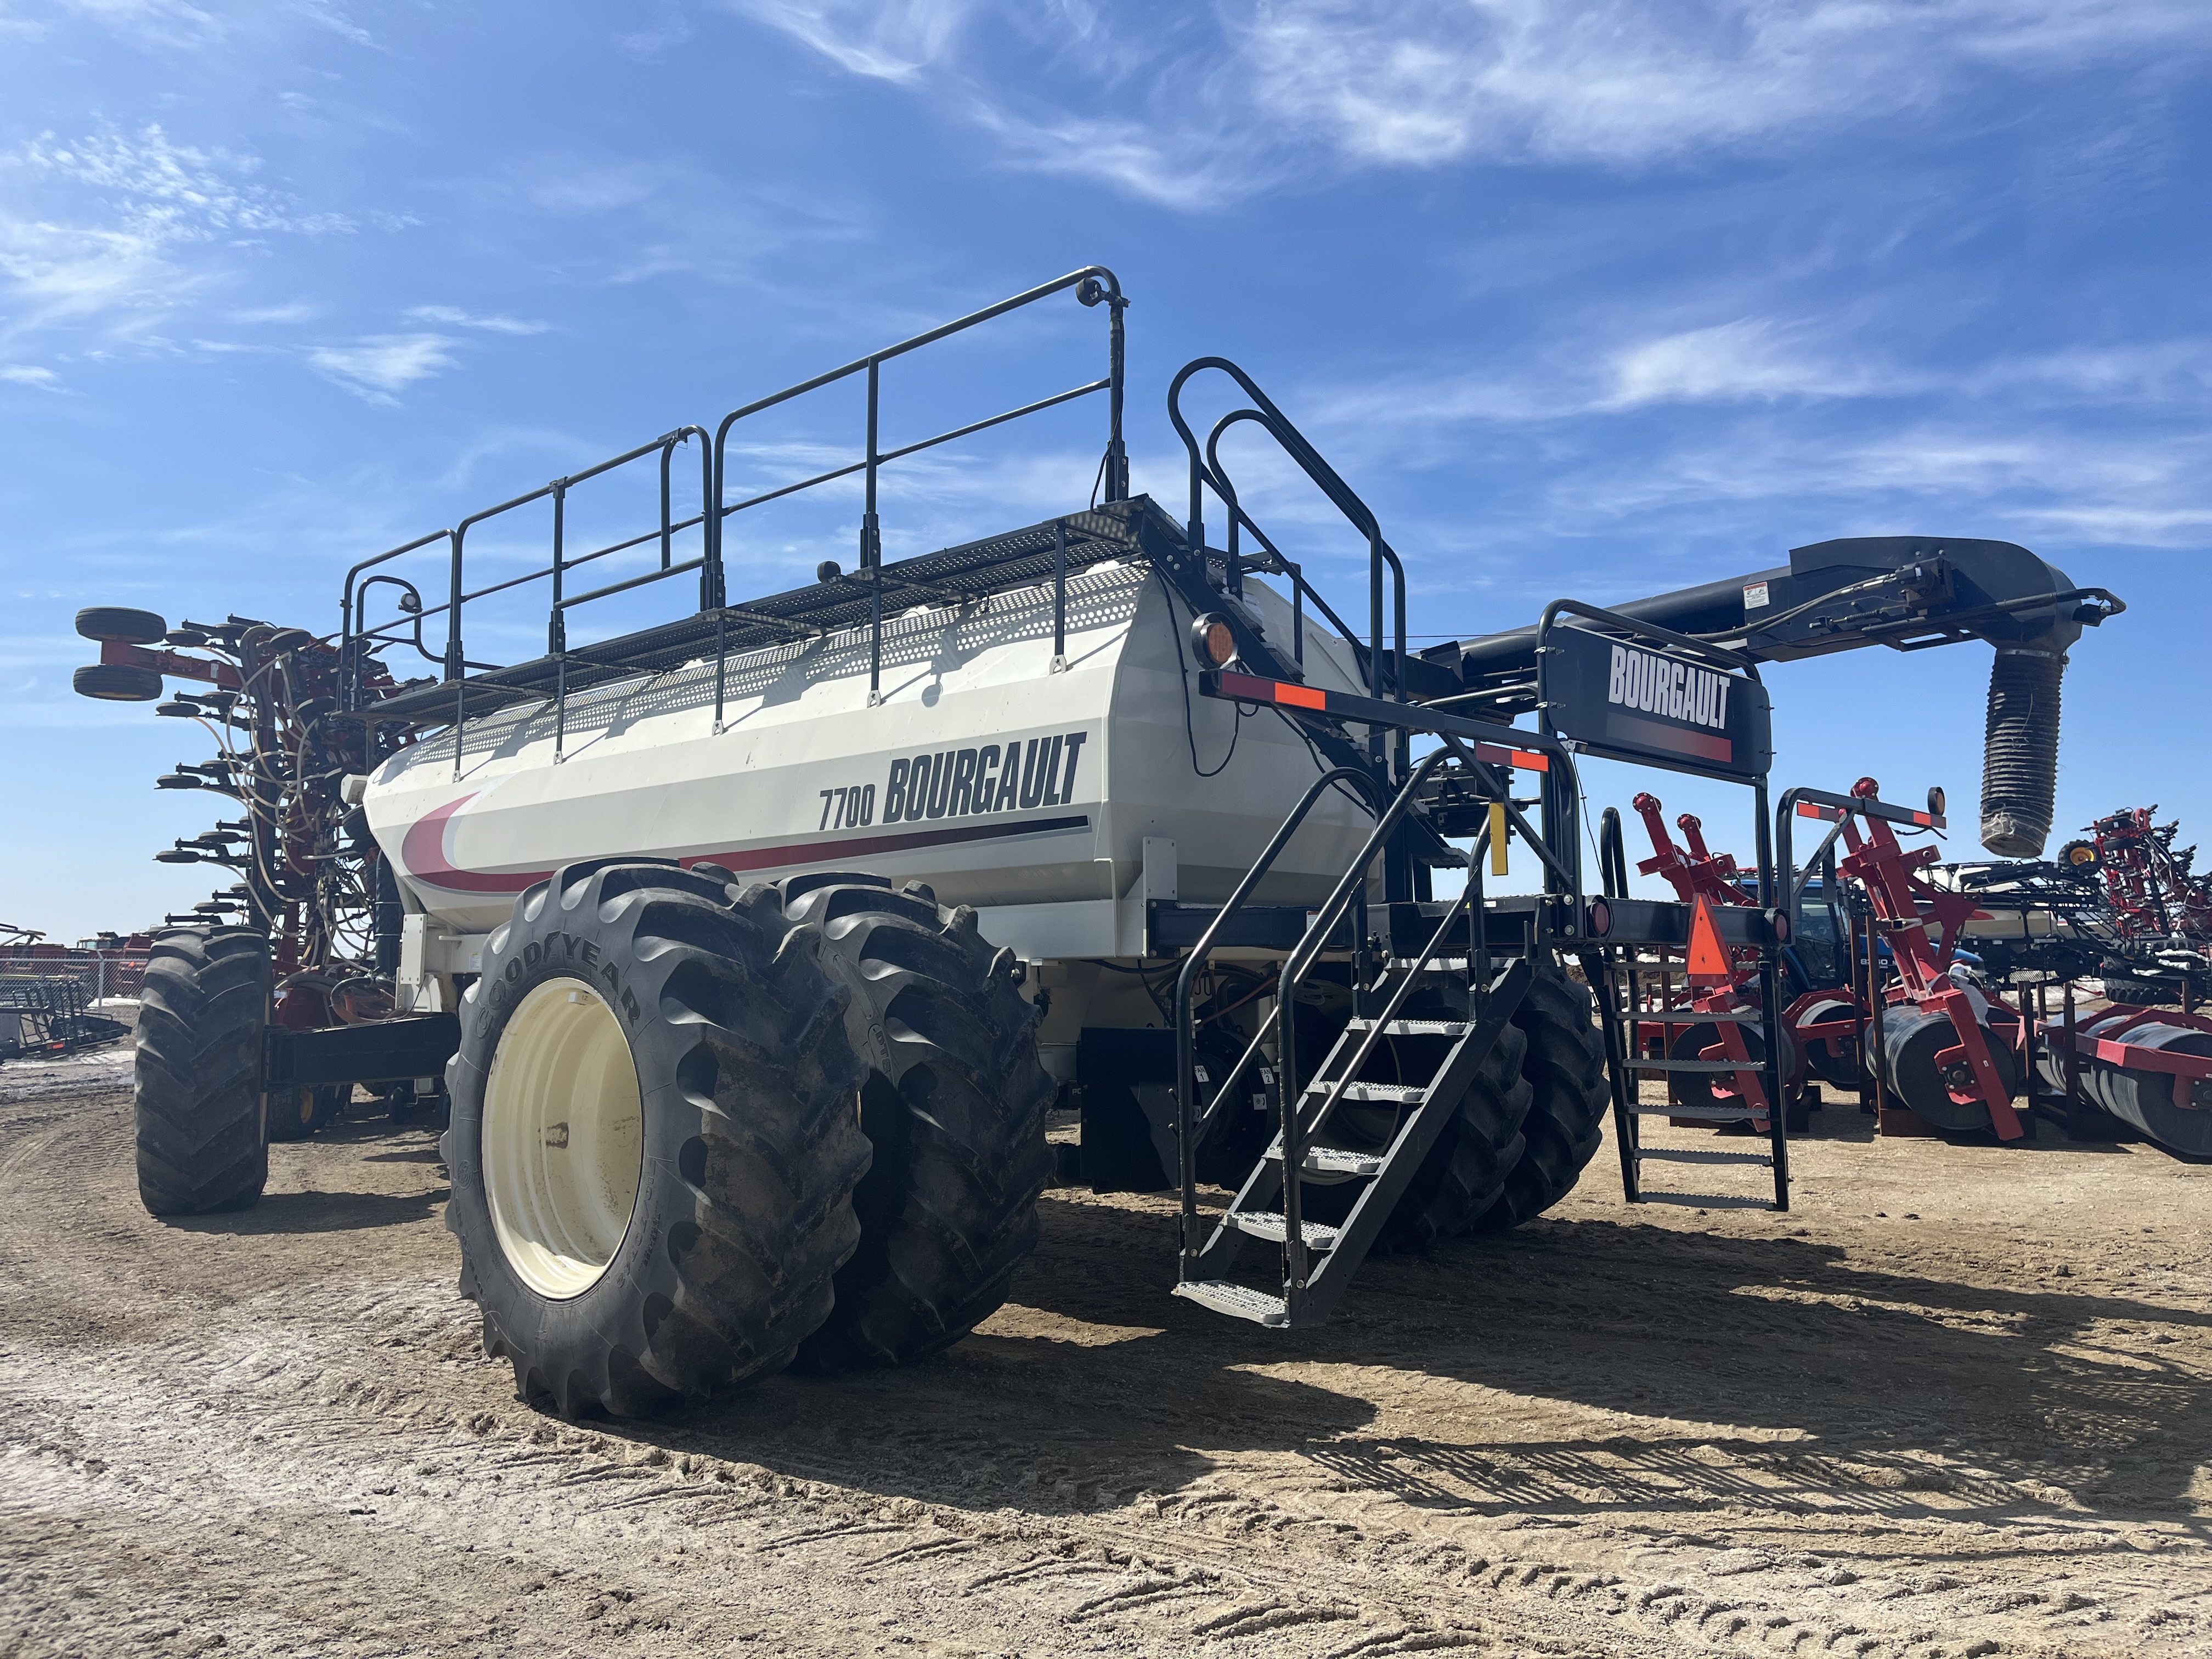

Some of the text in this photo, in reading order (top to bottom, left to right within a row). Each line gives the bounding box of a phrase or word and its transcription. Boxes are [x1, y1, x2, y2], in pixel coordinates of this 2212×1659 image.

[1609, 644, 1731, 730] BOURGAULT
[819, 732, 1087, 831] 7700 BOURGAULT
[476, 931, 640, 1038] GOODYEAR
